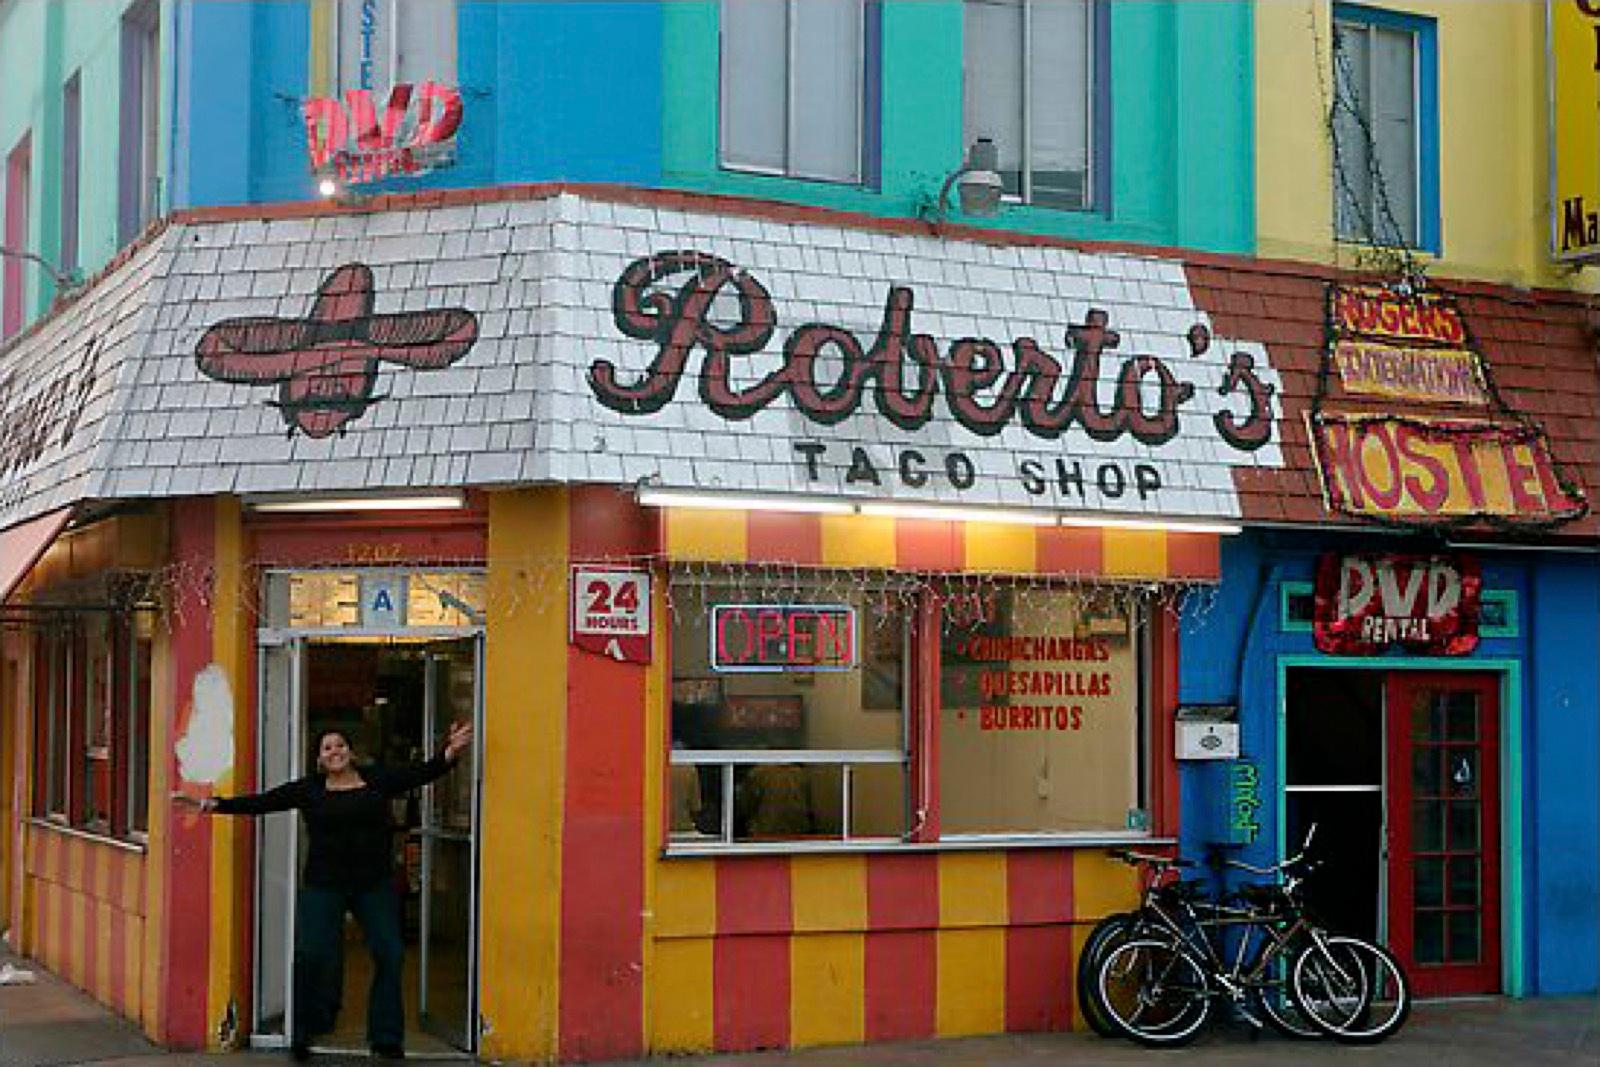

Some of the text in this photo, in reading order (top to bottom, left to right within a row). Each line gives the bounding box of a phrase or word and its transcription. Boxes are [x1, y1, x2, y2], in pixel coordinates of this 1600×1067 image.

[587, 250, 1277, 450] Roberto's
[795, 442, 1162, 501] TACO SHOP
[1315, 420, 1584, 513] HOSTEL
[372, 590, 394, 611] A
[586, 580, 639, 614] 24
[1337, 556, 1462, 622] DVD
[585, 615, 639, 631] HOURS
[717, 608, 853, 663] OPEN
[1361, 614, 1431, 644] RENTAL
[979, 705, 1083, 731] BURRITOS
